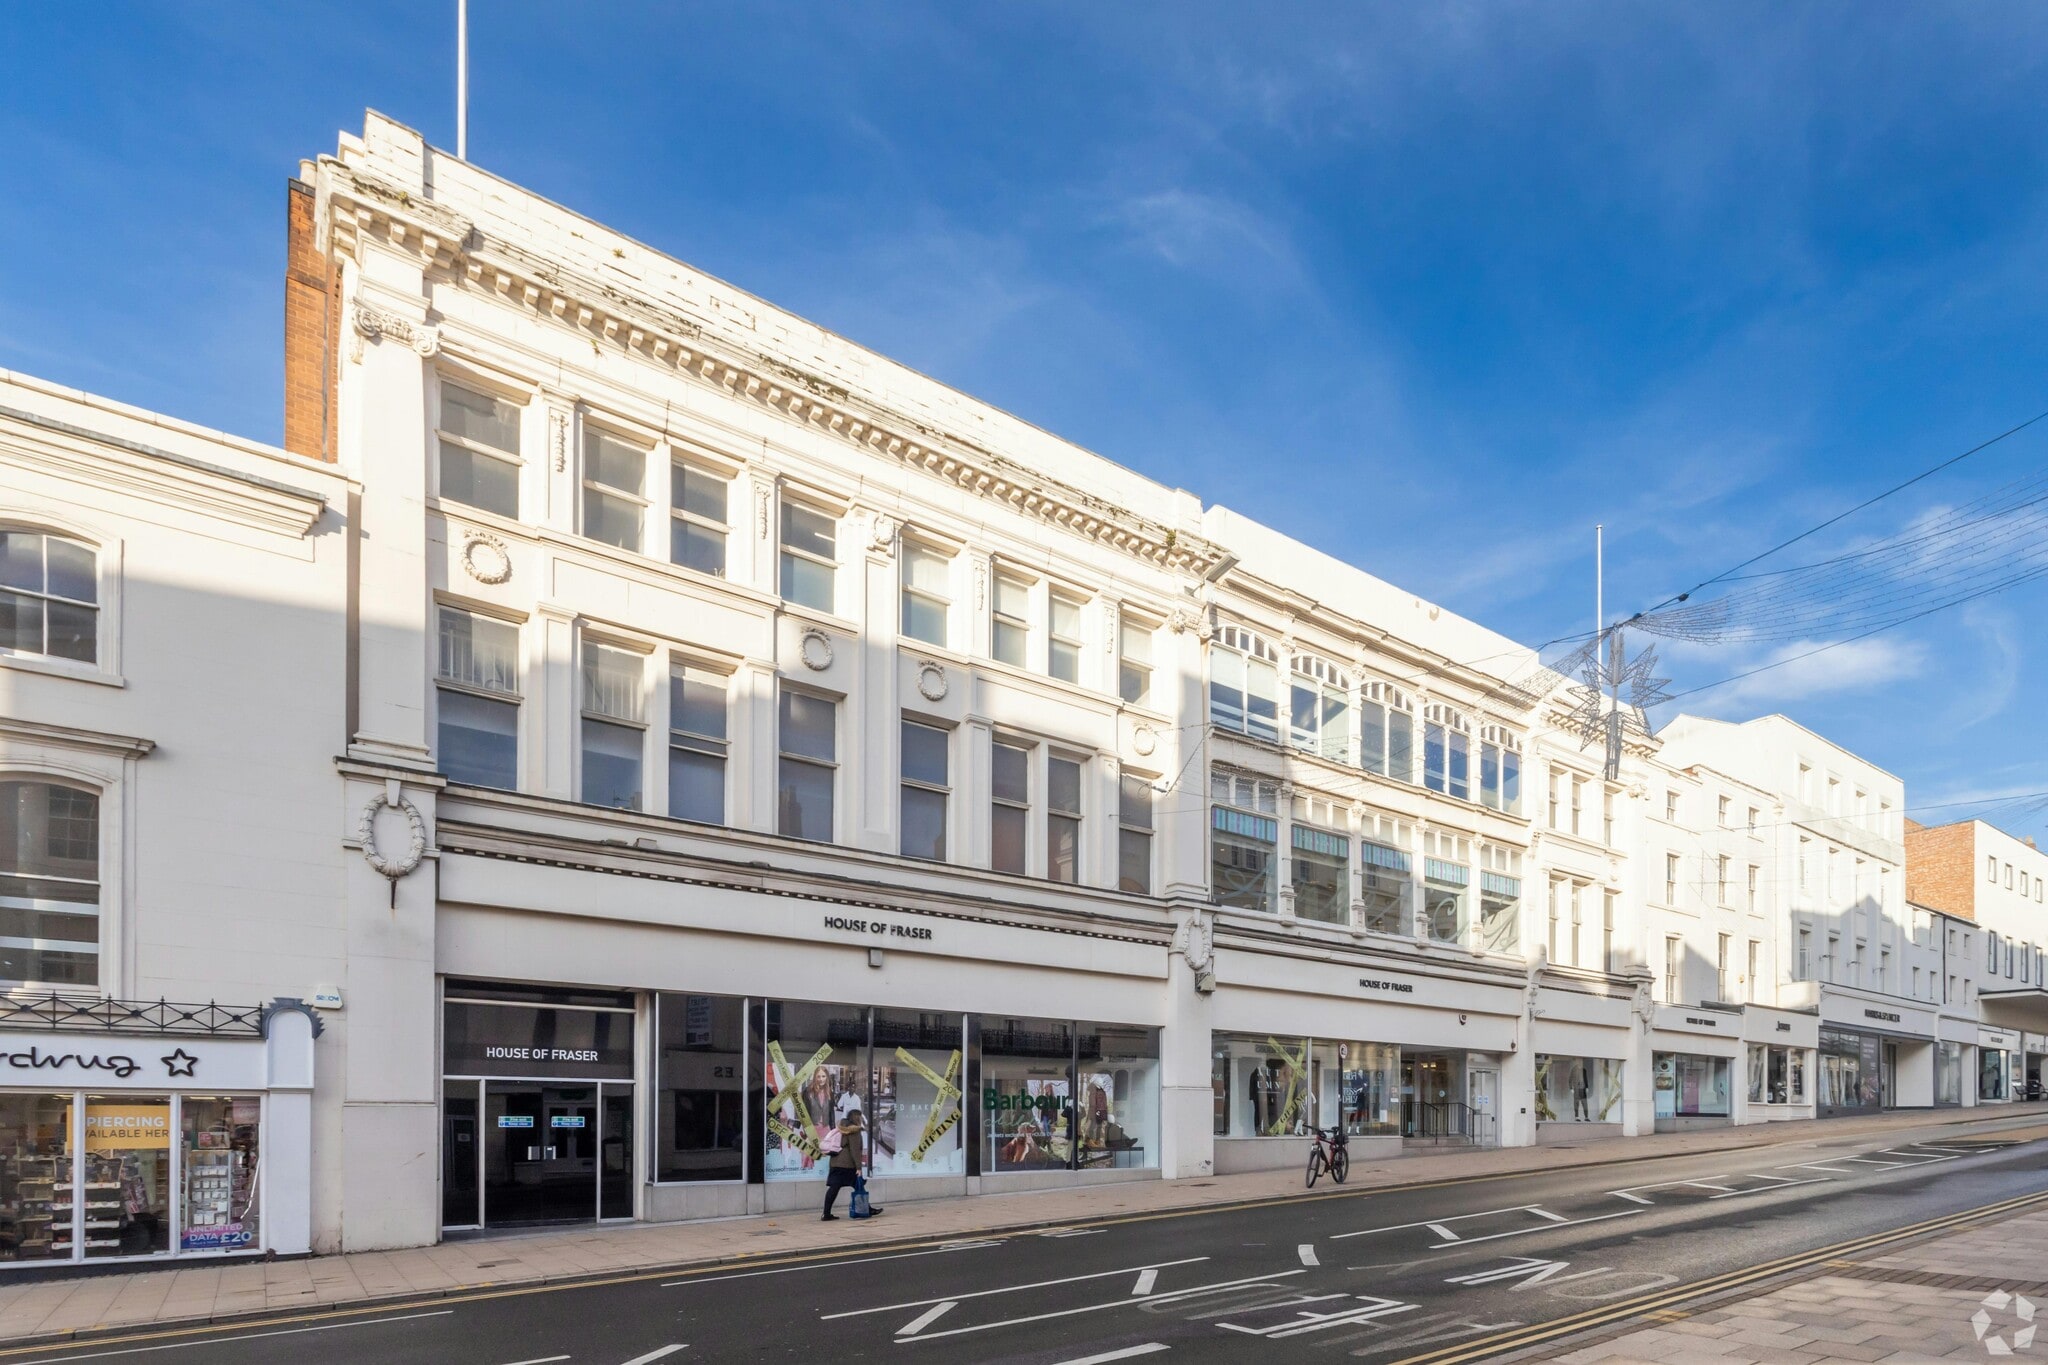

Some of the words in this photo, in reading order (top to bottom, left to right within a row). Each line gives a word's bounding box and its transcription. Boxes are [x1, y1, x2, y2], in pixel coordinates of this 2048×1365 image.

[824, 916, 867, 932] HOUSE
[870, 922, 887, 934] OF
[890, 924, 932, 940] FRASER
[1359, 979, 1381, 989] HOUSE
[1381, 981, 1390, 990] OF
[1391, 982, 1413, 993] FRASER
[486, 1047, 530, 1059] HOUSE
[532, 1048, 549, 1060] OF
[551, 1049, 598, 1061] FRASER
[983, 1088, 1070, 1111] Barbour
[87, 1116, 165, 1127] PIERCING
[768, 1120, 787, 1134] OFF
[85, 1129, 141, 1138] AILABLE
[145, 1129, 169, 1138] HER
[919, 1111, 960, 1153] GIFTING
[188, 1222, 243, 1234] UNLIMITED
[189, 1233, 219, 1242] DATA
[220, 1231, 252, 1243] £20
